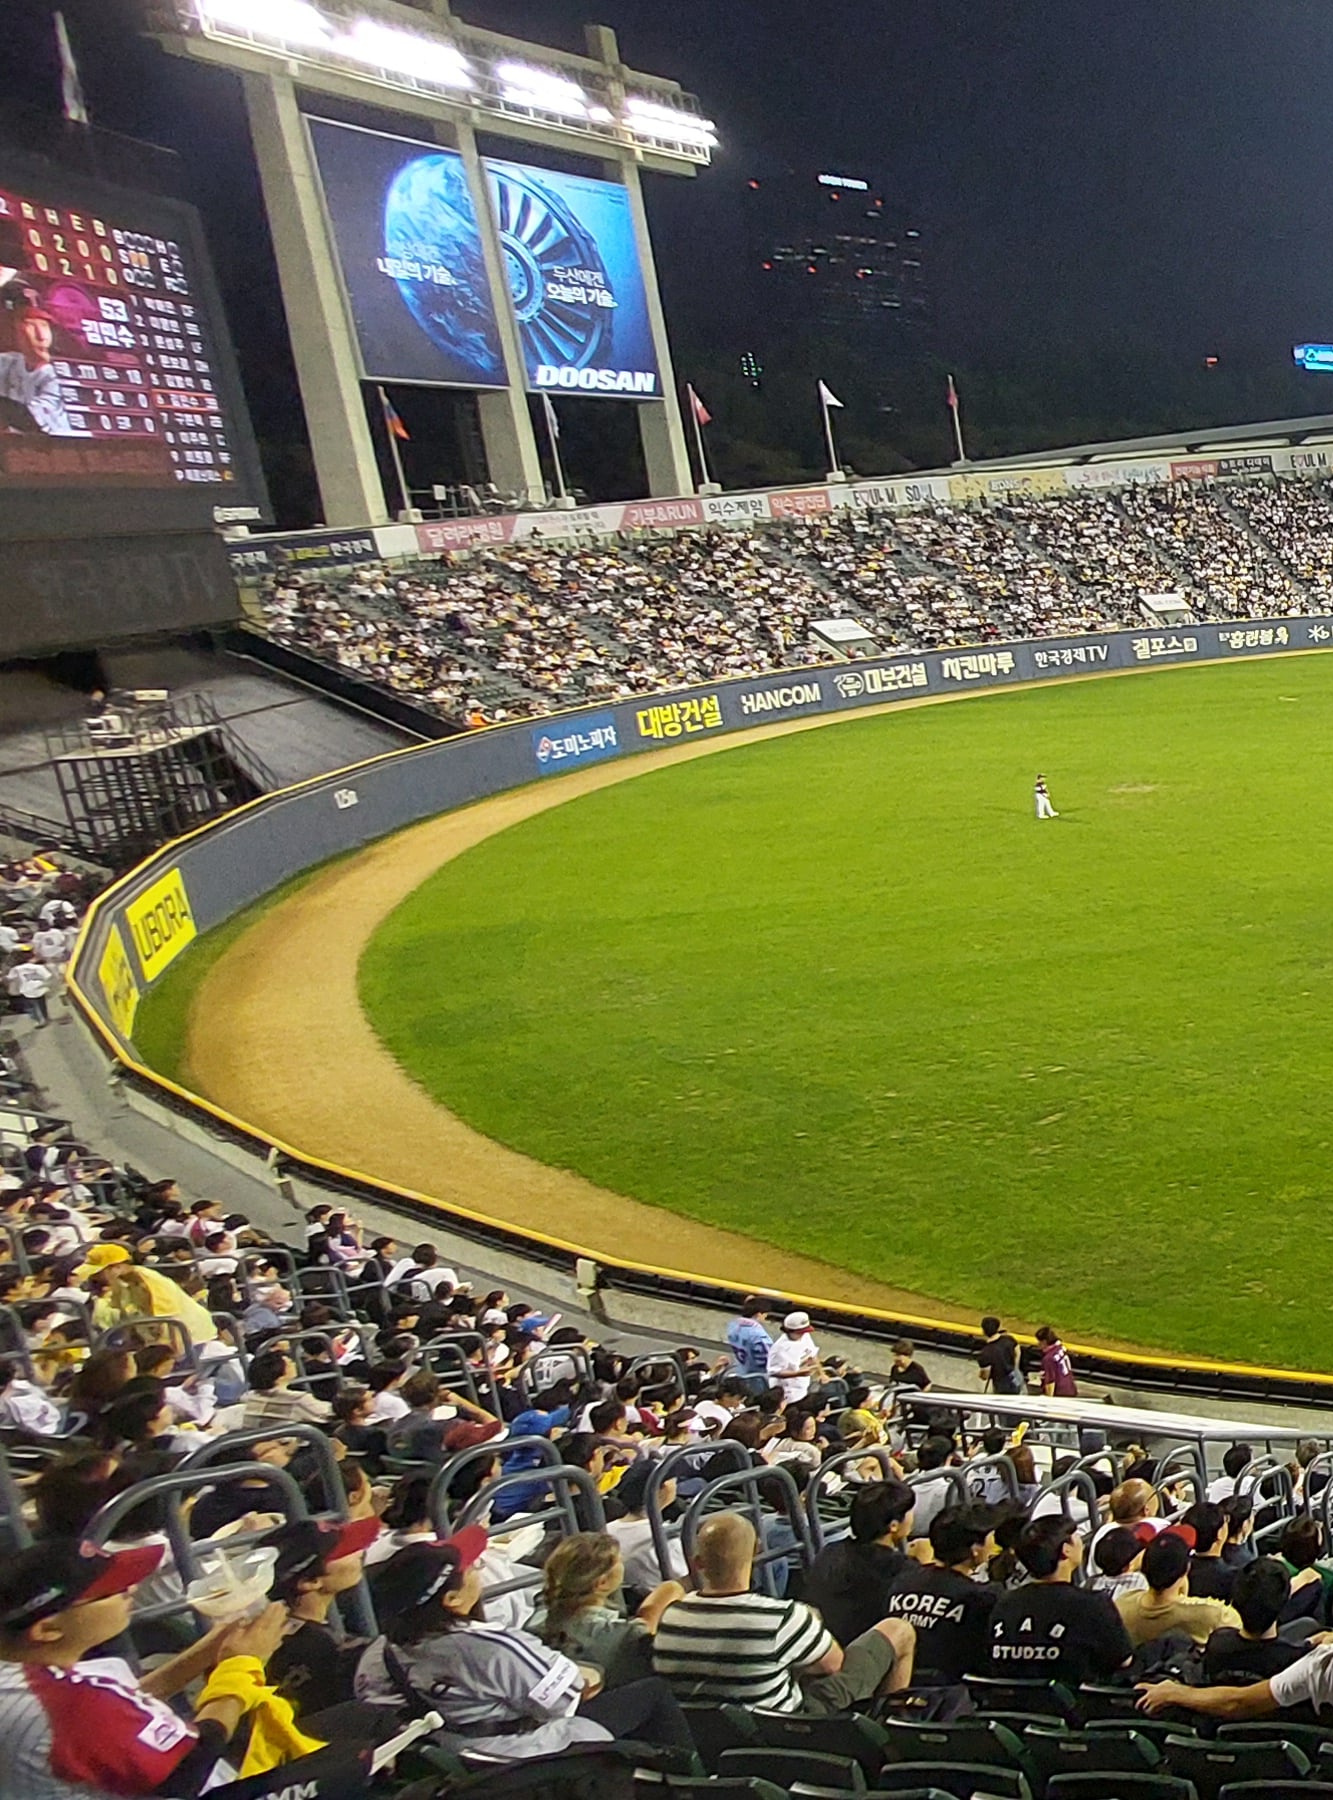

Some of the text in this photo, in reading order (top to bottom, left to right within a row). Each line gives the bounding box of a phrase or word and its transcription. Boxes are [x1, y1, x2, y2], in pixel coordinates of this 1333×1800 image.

[44, 208, 60, 226] H
[70, 213, 85, 232] E
[53, 234, 67, 253] 2
[59, 258, 74, 276] 2
[98, 297, 130, 322] 53
[536, 365, 656, 393] DOOSAN
[631, 503, 698, 525] 기부&RUN
[708, 499, 763, 517] 익수제약
[942, 652, 1015, 680] 치킨마루
[1034, 644, 1108, 667] 한국경제TV
[865, 662, 928, 695] 대보건설
[741, 682, 822, 715] HANCOM
[636, 695, 724, 739] 대방건설
[551, 726, 618, 761] 도미노피자
[133, 886, 192, 962] UBORA
[889, 1593, 966, 1623] KOREA
[901, 1613, 938, 1630] ARMY
[992, 1645, 1060, 1660] STUDIO
